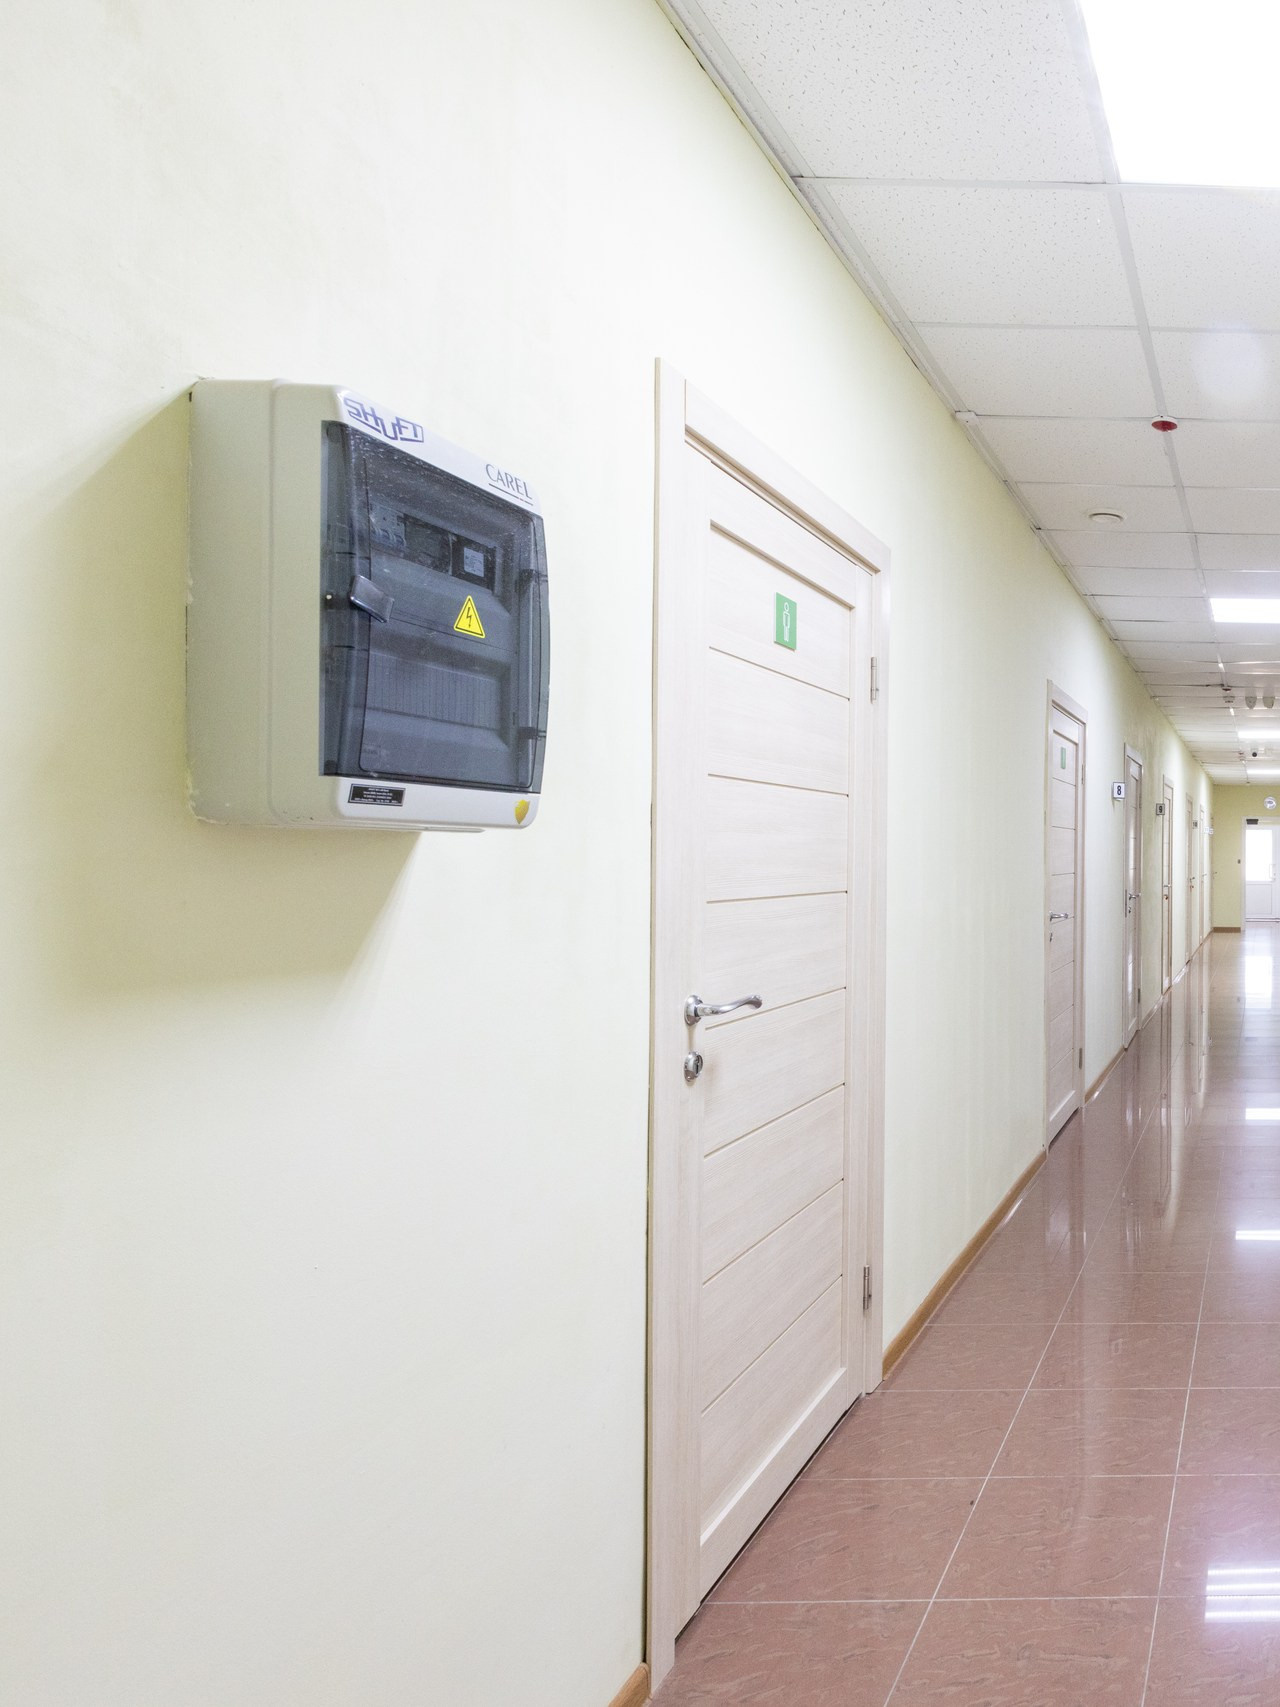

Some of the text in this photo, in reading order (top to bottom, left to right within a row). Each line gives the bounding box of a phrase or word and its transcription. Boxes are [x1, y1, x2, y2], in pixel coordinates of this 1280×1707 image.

[344, 397, 424, 443] SHUFT
[486, 464, 532, 500] CAREL
[1116, 784, 1122, 796] 8
[1158, 805, 1163, 813] 9
